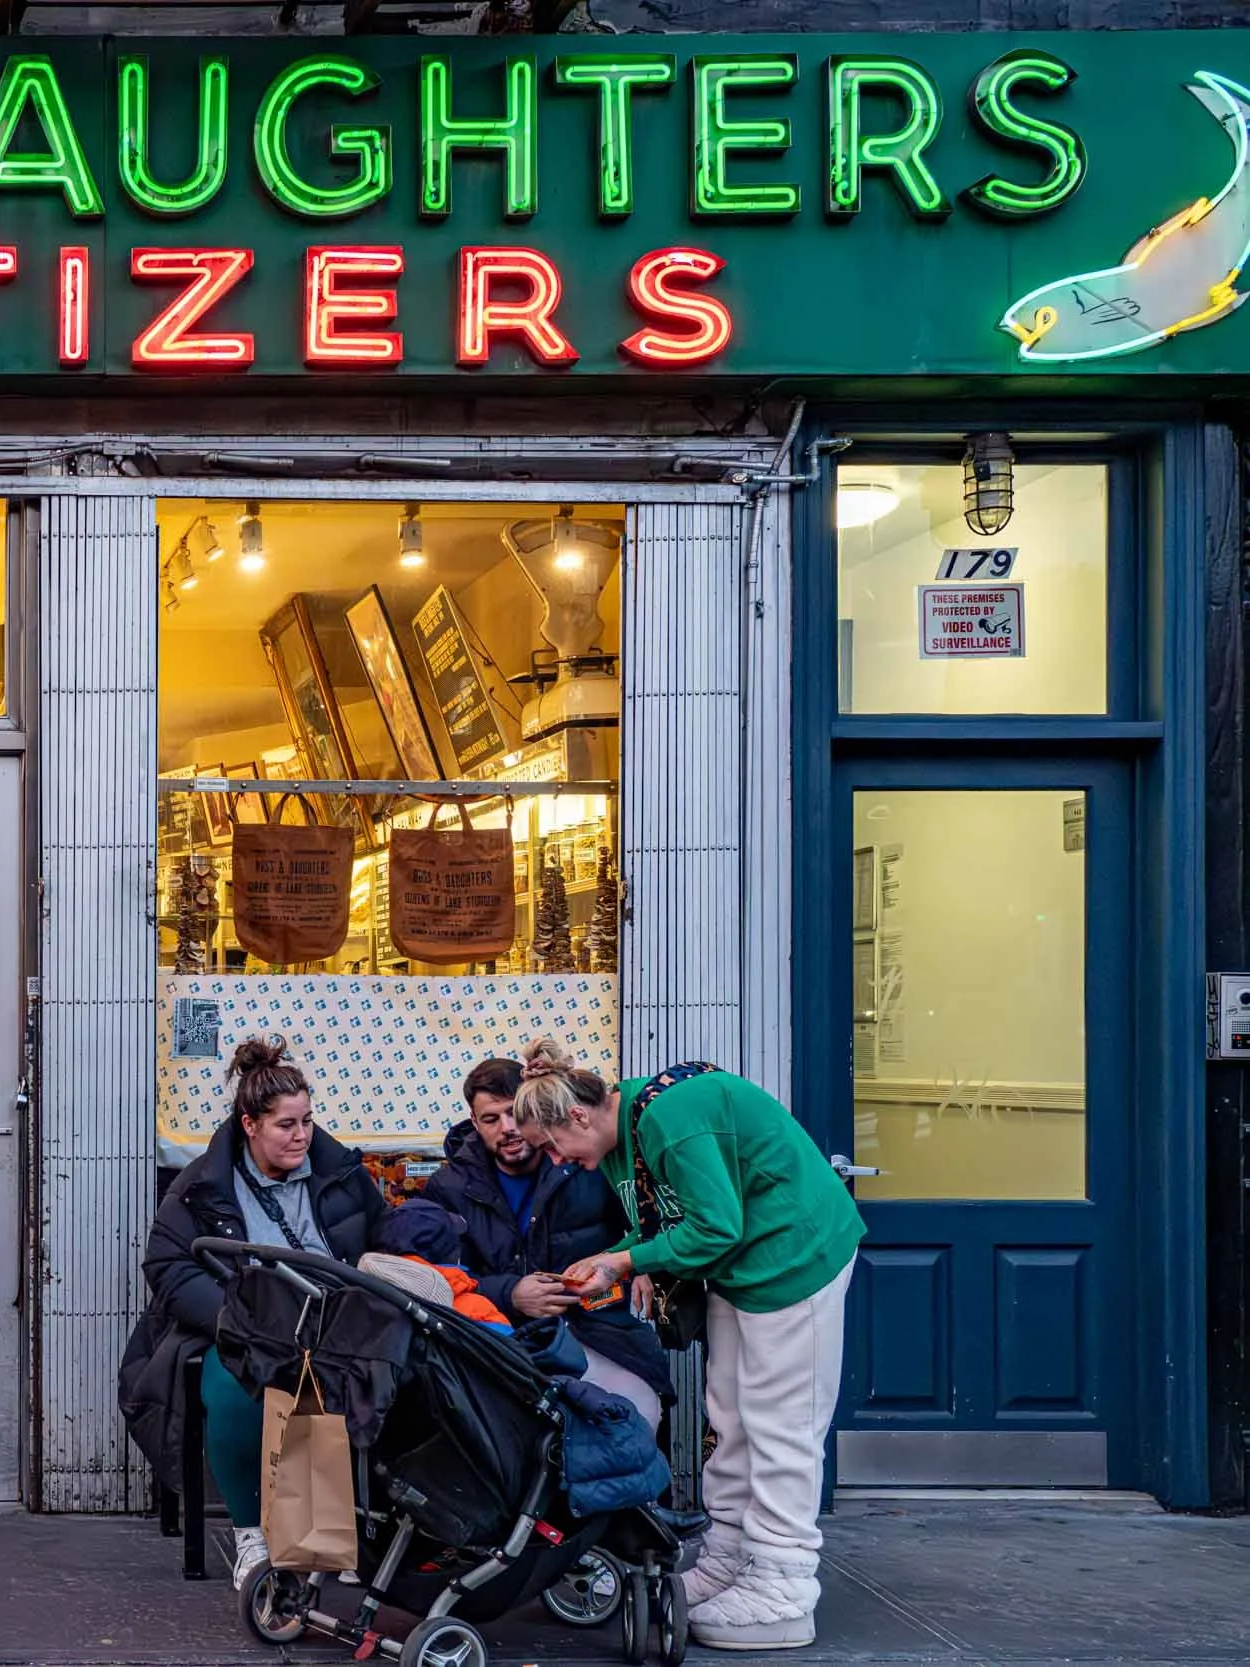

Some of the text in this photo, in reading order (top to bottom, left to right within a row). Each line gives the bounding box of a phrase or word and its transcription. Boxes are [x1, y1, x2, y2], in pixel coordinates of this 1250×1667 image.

[945, 550, 1012, 578] 179
[932, 594, 1005, 603] THESE PREMISES
[932, 606, 995, 616] PROTECTED BY
[942, 621, 974, 633] VIDEO
[932, 637, 1011, 649] SURVEILLANCE
